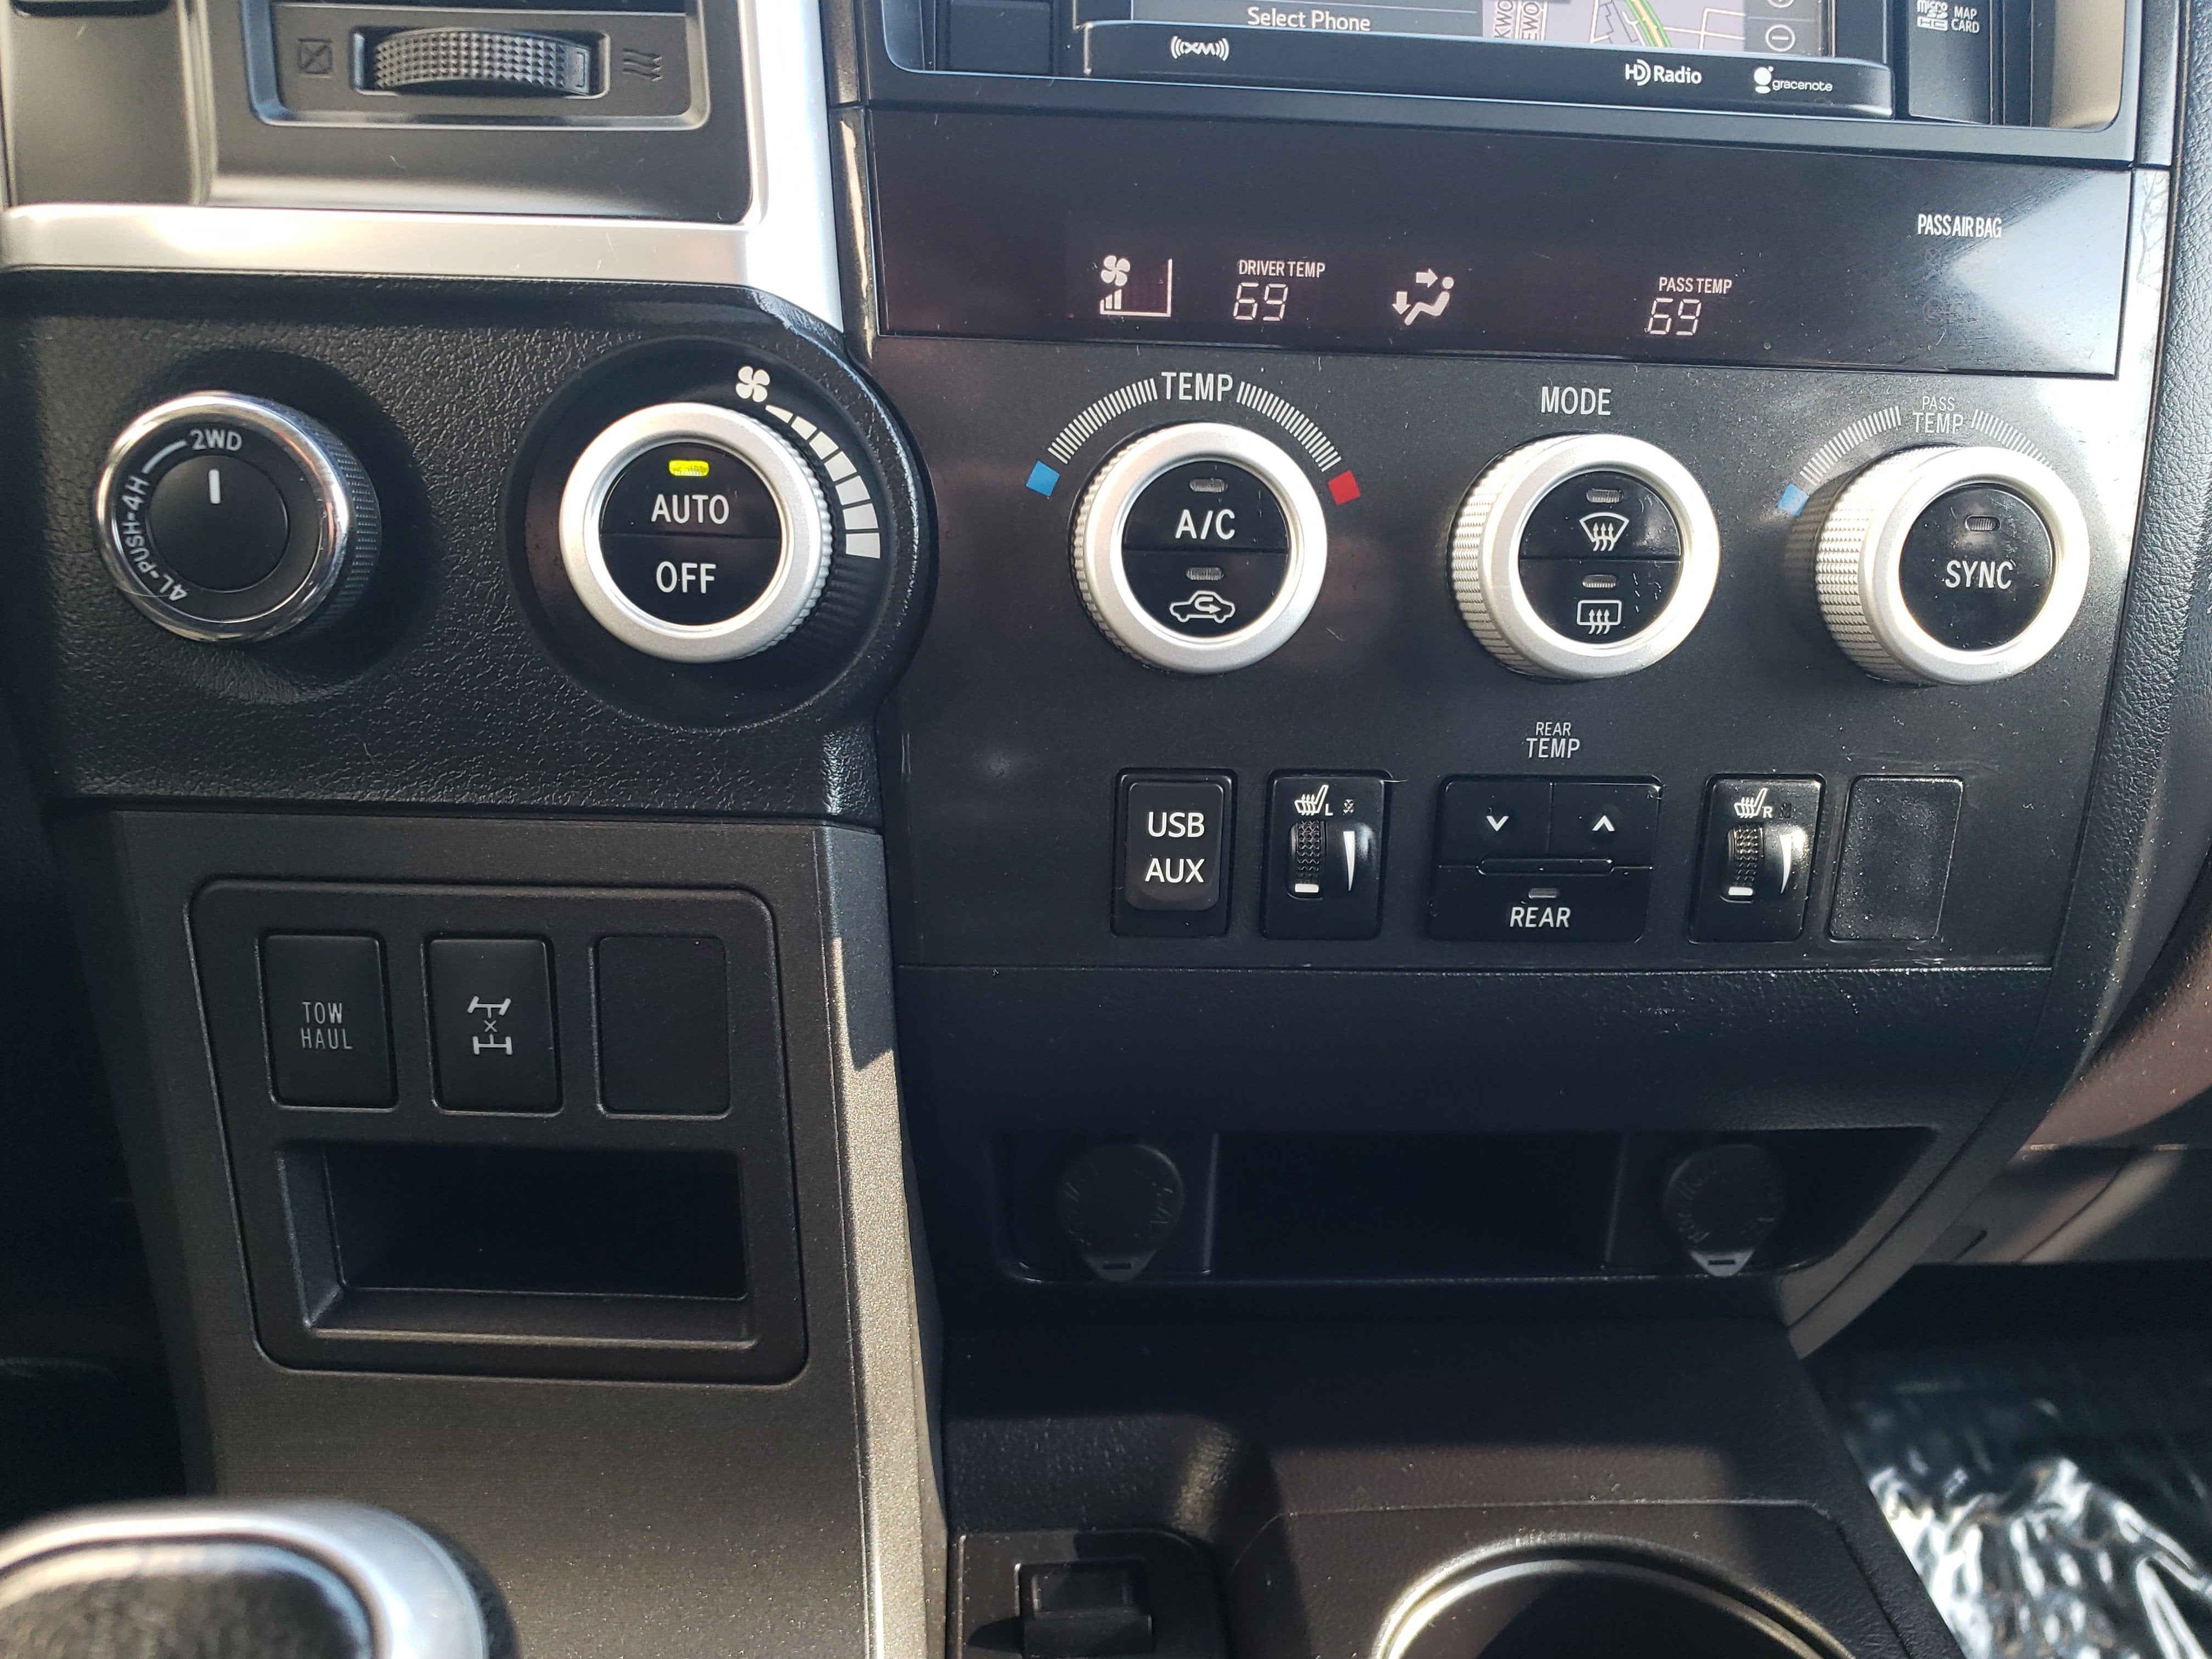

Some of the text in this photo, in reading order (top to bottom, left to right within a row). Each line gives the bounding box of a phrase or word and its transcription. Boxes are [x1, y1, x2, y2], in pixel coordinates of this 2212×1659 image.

[1247, 7, 1371, 32] Select Phone
[1954, 5, 1977, 20] MAP
[1951, 19, 1980, 33] CARD
[1654, 65, 1702, 84] Radio
[1772, 79, 1833, 92] gracenote
[1918, 214, 2002, 238] PASS AIR BAG
[1239, 259, 1325, 278] DRIVER TEMP
[1659, 276, 1732, 294] PASS TEMP
[1233, 283, 1288, 321] 69
[1647, 298, 1701, 336] 69
[1161, 371, 1233, 402] TEMP
[1541, 386, 1612, 416] MODE
[1922, 396, 1955, 411] PASS
[1913, 411, 1963, 434] TEMP
[189, 429, 243, 452] 2WD
[651, 494, 730, 524] AUTO
[1175, 509, 1236, 540] A/C
[656, 561, 716, 594] OFF
[1945, 559, 2014, 590] SYNC
[1536, 721, 1571, 737] REAR
[1526, 737, 1581, 759] TEMP
[1325, 804, 1333, 816] L
[1763, 806, 1773, 819] R
[1147, 811, 1205, 838] USB
[1144, 857, 1205, 883] AUX
[1510, 906, 1571, 928] REAR
[302, 1002, 343, 1024] TOW
[301, 1028, 353, 1049] HAUL
